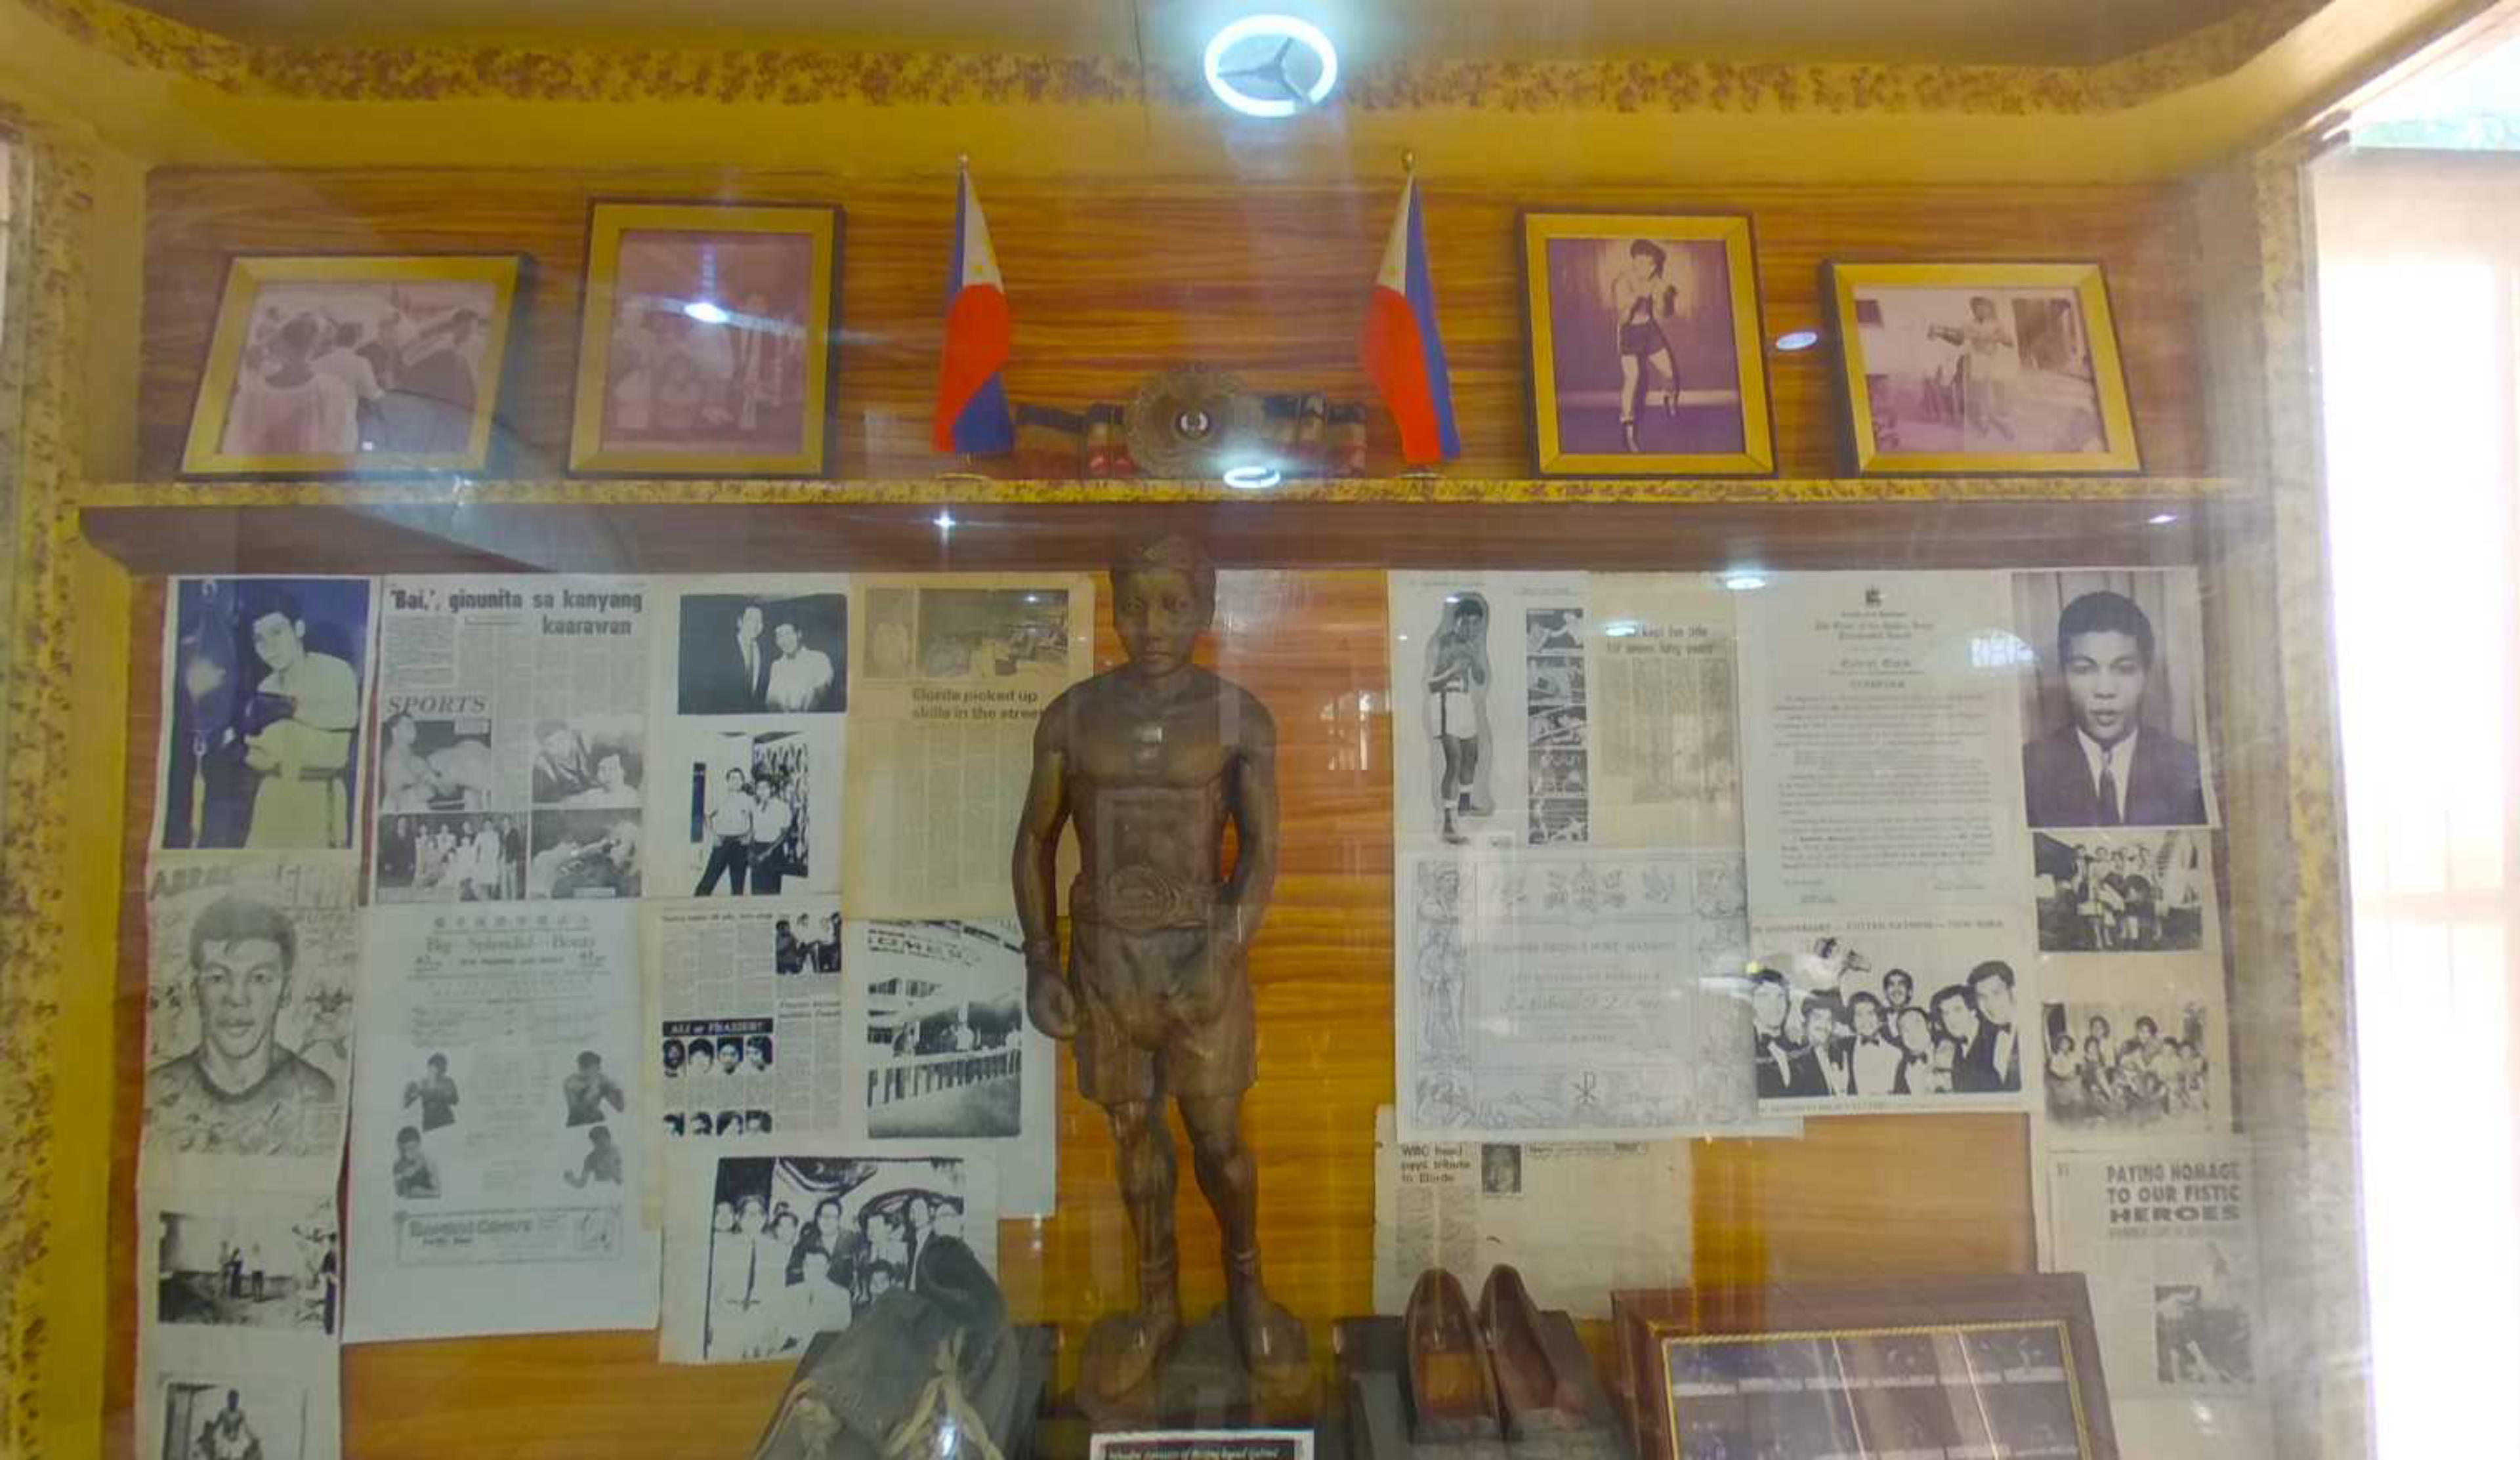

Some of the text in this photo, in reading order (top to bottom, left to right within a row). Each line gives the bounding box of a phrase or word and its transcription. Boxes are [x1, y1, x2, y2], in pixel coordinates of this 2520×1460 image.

[449, 589, 522, 612] ginunita
[532, 593, 554, 608] sa
[563, 590, 642, 612] kanyang
[543, 615, 632, 635] kaarawan
[387, 694, 487, 715] SPORTS
[963, 688, 1015, 703] picked
[1018, 691, 1037, 704] up
[912, 707, 950, 720] skills
[955, 707, 968, 720] in
[972, 707, 996, 720] the
[2107, 1161, 2241, 1182] PAYING HOMAGE
[2107, 1184, 2240, 1204] TO OUR FISTIC
[2109, 1205, 2240, 1223] HEROES
